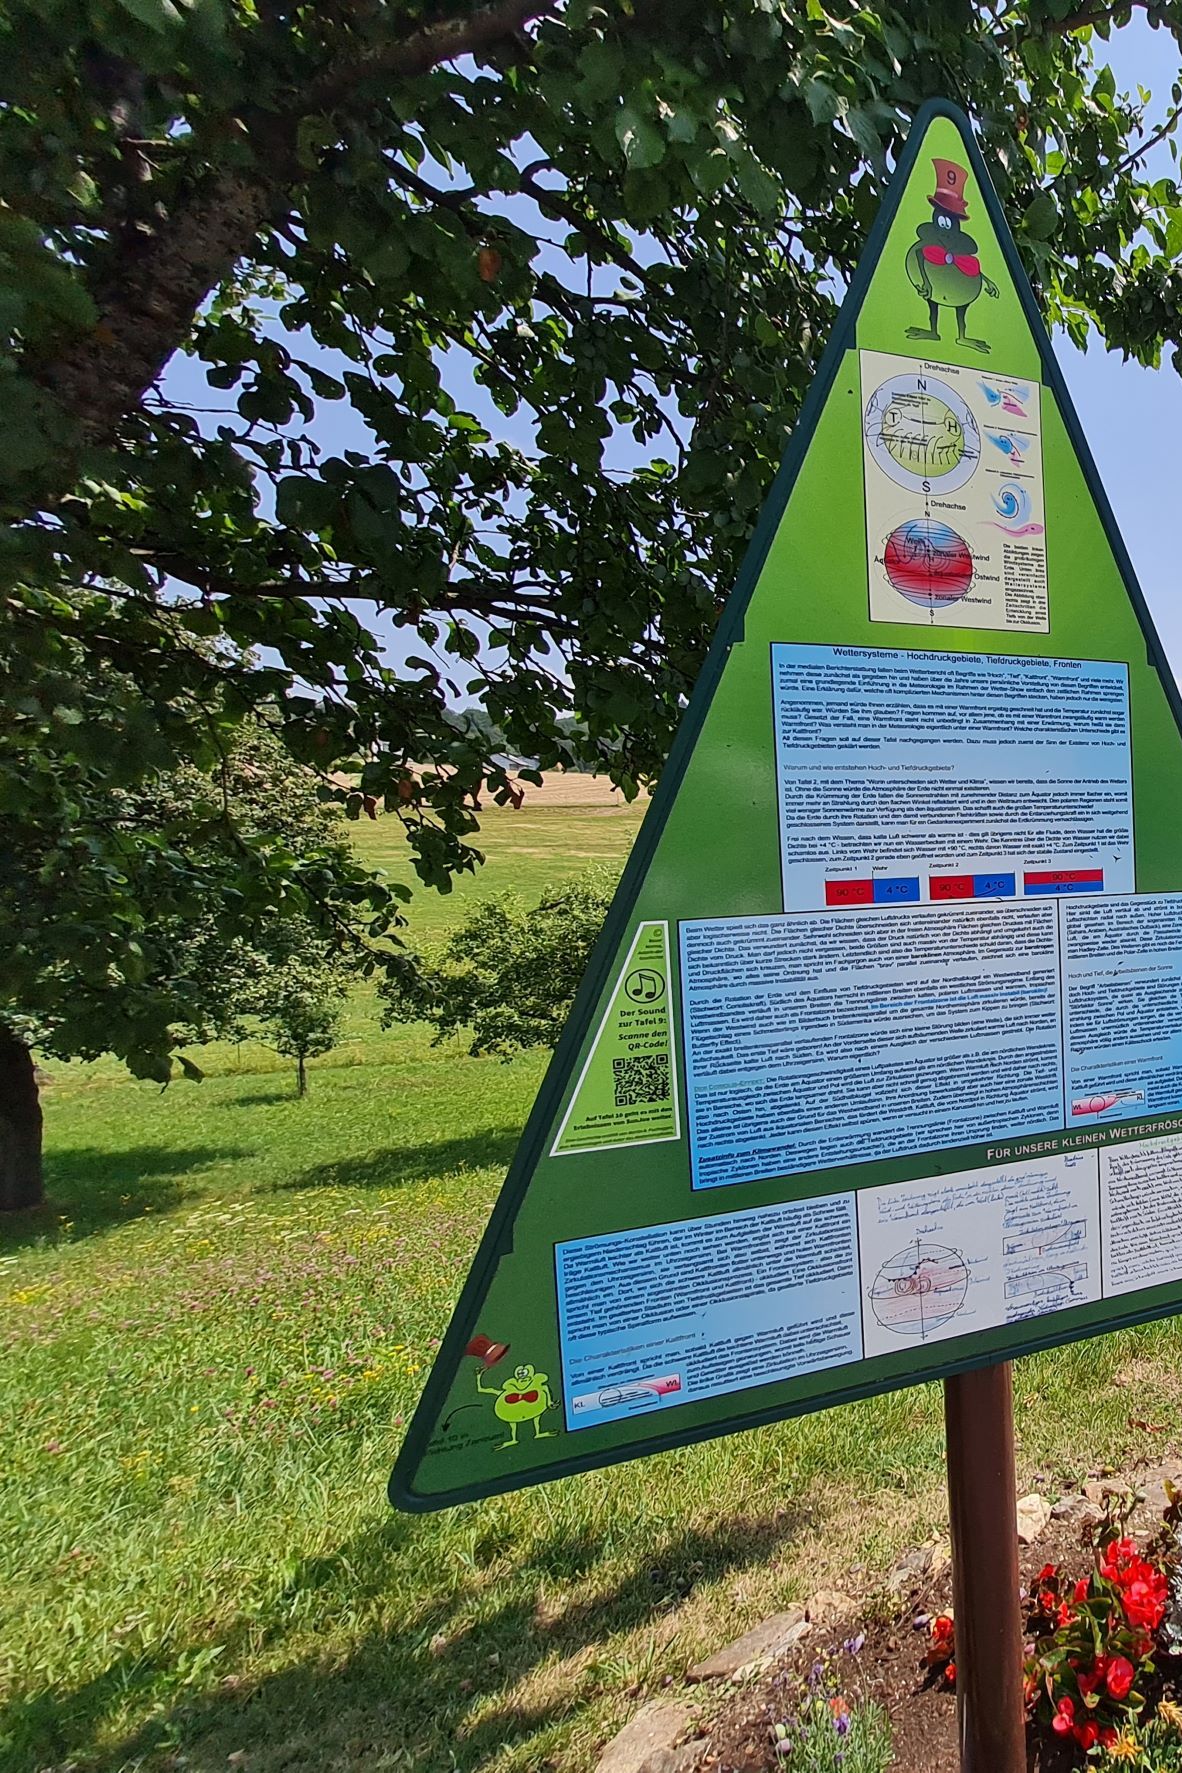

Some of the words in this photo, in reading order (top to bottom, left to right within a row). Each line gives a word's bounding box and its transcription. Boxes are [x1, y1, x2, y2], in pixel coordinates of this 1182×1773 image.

[946, 169, 957, 186] 9
[924, 362, 960, 375] Drehachse
[917, 378, 927, 391] N
[889, 411, 899, 423] T
[947, 420, 958, 433] H
[922, 480, 931, 493] S
[930, 499, 967, 511] Drehachse
[924, 510, 931, 518] N
[974, 573, 1000, 582] Ostwind
[961, 596, 992, 605] Westwind
[929, 609, 935, 617] S
[832, 647, 899, 660] Wettersysteme
[906, 652, 984, 665] Hochdruckgebiete,
[985, 656, 1052, 668] Tiefdruckgebiete,
[1053, 659, 1083, 669] Fronten
[1052, 873, 1063, 881] 90
[835, 888, 849, 897] 90
[886, 886, 893, 894] 4
[939, 883, 951, 892] 90
[620, 1010, 636, 1018] Der
[638, 1006, 666, 1016] Sound
[635, 1017, 657, 1026] Tafel
[658, 1016, 667, 1025] 9:
[618, 1032, 650, 1041] Scanne
[651, 1030, 668, 1038] den
[628, 1039, 668, 1052] QR-Code!
[986, 1147, 1011, 1161] FÜR
[1014, 1139, 1059, 1156] UNSERE
[1062, 1132, 1106, 1148] KLEINEN
